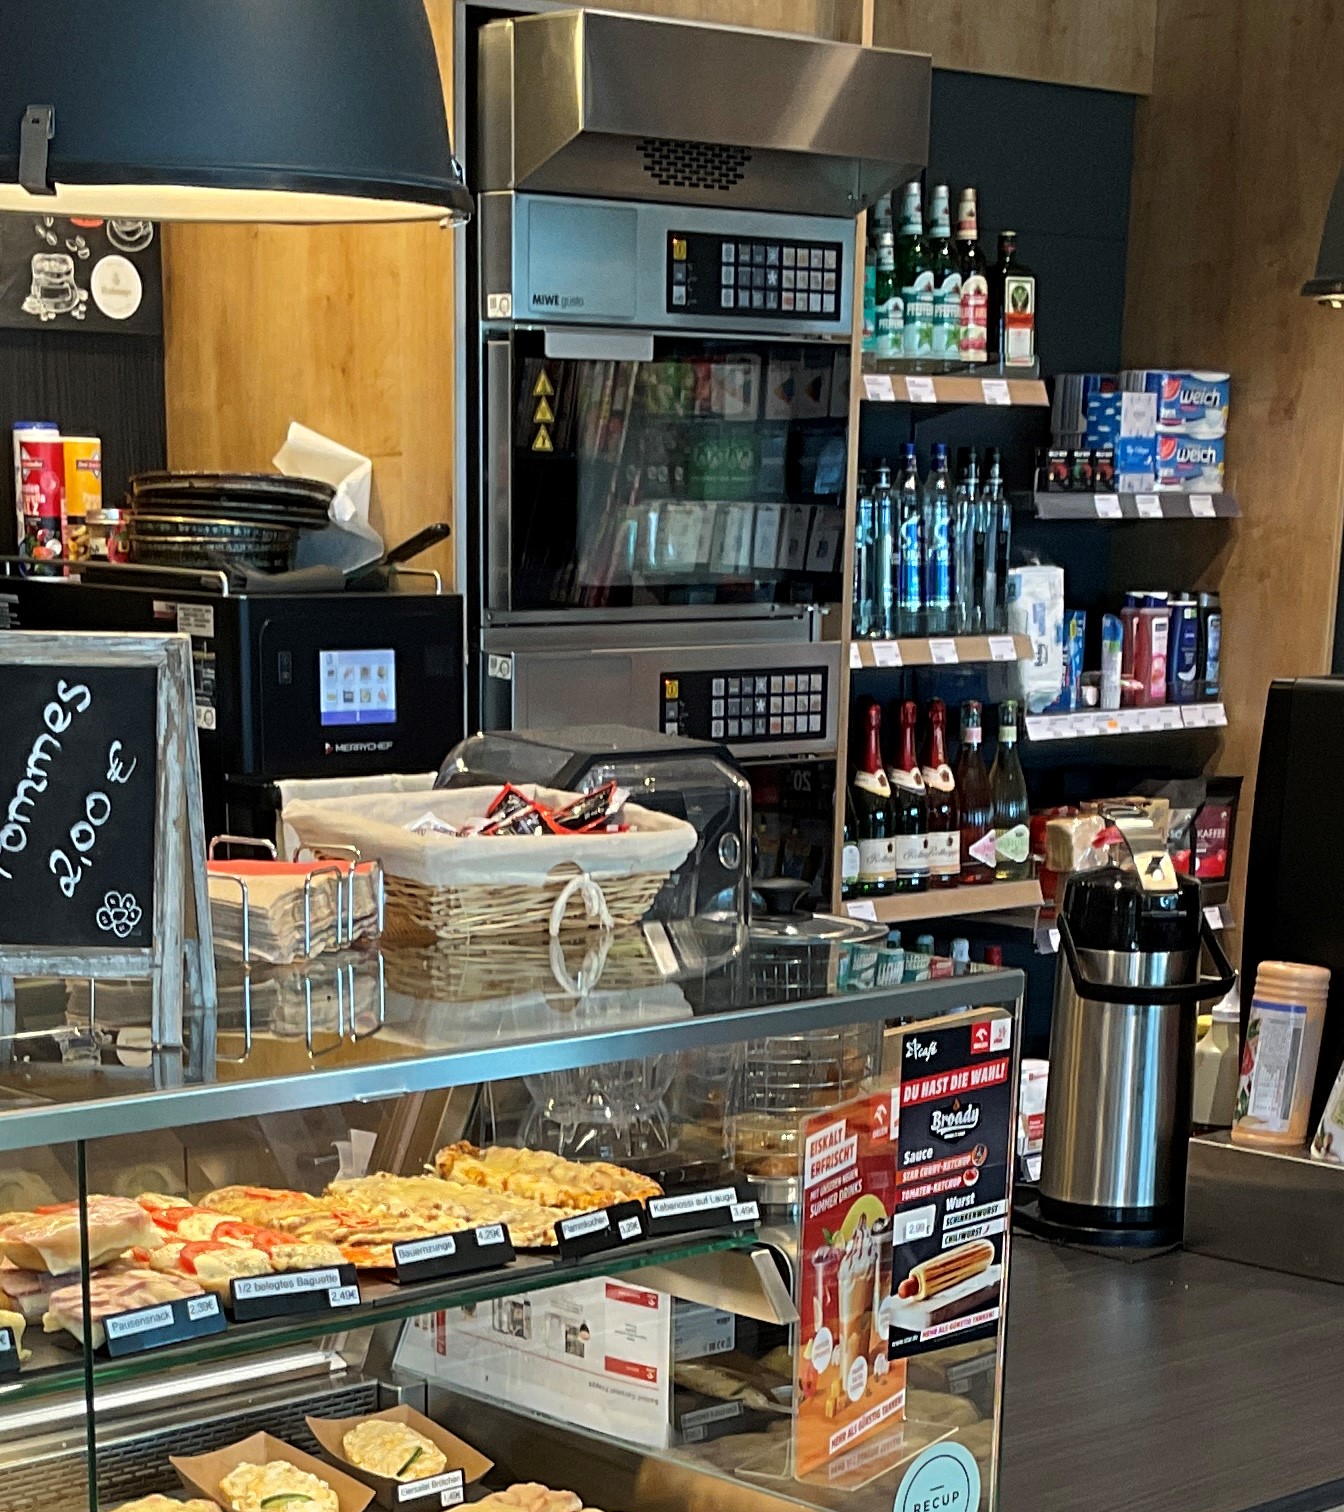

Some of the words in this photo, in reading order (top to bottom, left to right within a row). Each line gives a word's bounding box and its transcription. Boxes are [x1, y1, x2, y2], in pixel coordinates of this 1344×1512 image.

[532, 292, 560, 307] MIWE
[1179, 388, 1221, 406] weich
[1176, 446, 1217, 464] weich
[903, 1083, 920, 1103] DU
[920, 1076, 949, 1099] HAST
[950, 1072, 969, 1091] DIE
[970, 1062, 1006, 1086] WAHL!
[930, 1103, 980, 1132] Broady
[810, 1127, 844, 1156] EISKALT
[811, 1142, 856, 1180] ERFRISCHT
[903, 1147, 934, 1165] Sauce
[946, 1191, 976, 1211] Wurst
